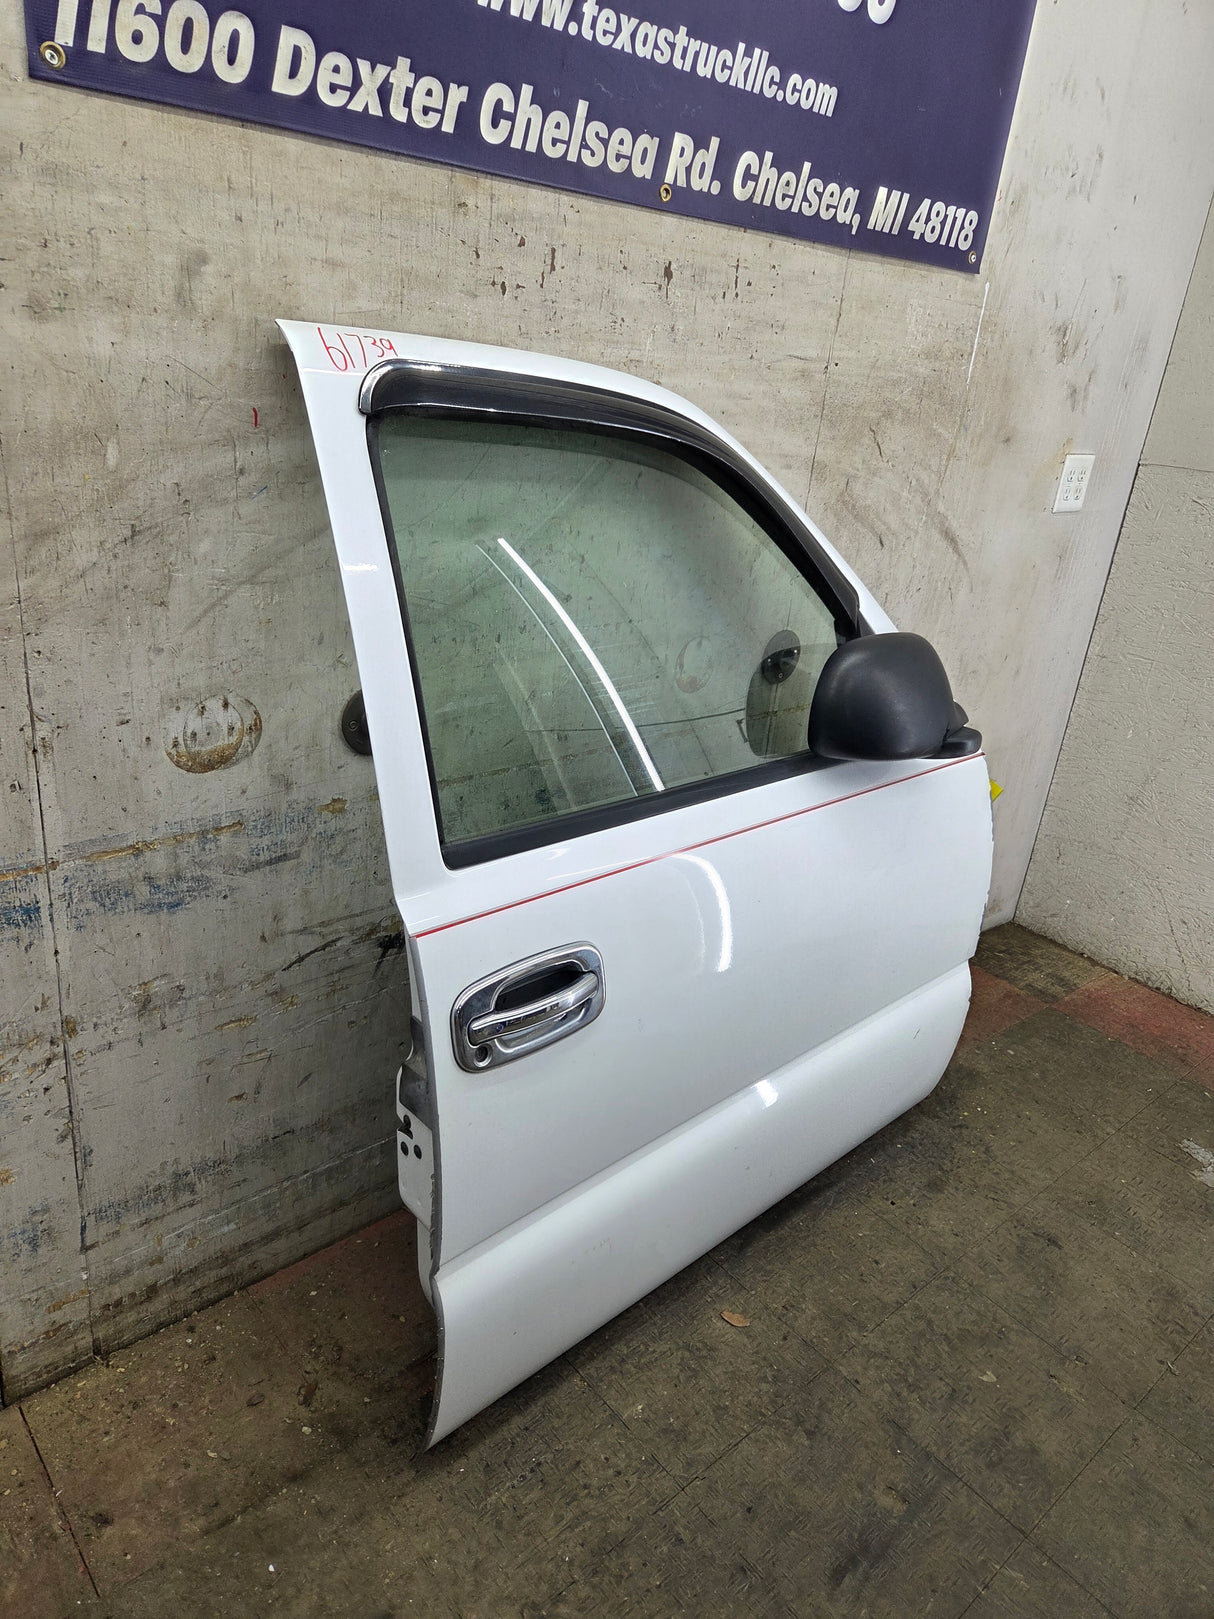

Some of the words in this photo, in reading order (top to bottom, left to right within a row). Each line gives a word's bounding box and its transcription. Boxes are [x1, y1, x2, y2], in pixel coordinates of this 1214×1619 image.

[477, 0, 838, 118] ww.texastruckllc.com
[271, 24, 469, 134] Dexter
[479, 82, 660, 180] Chelsea
[664, 131, 722, 196] Rd.
[732, 150, 861, 236] Chelsea,
[867, 186, 911, 236] MI
[908, 198, 979, 251] 48118
[317, 326, 398, 372] 61739
